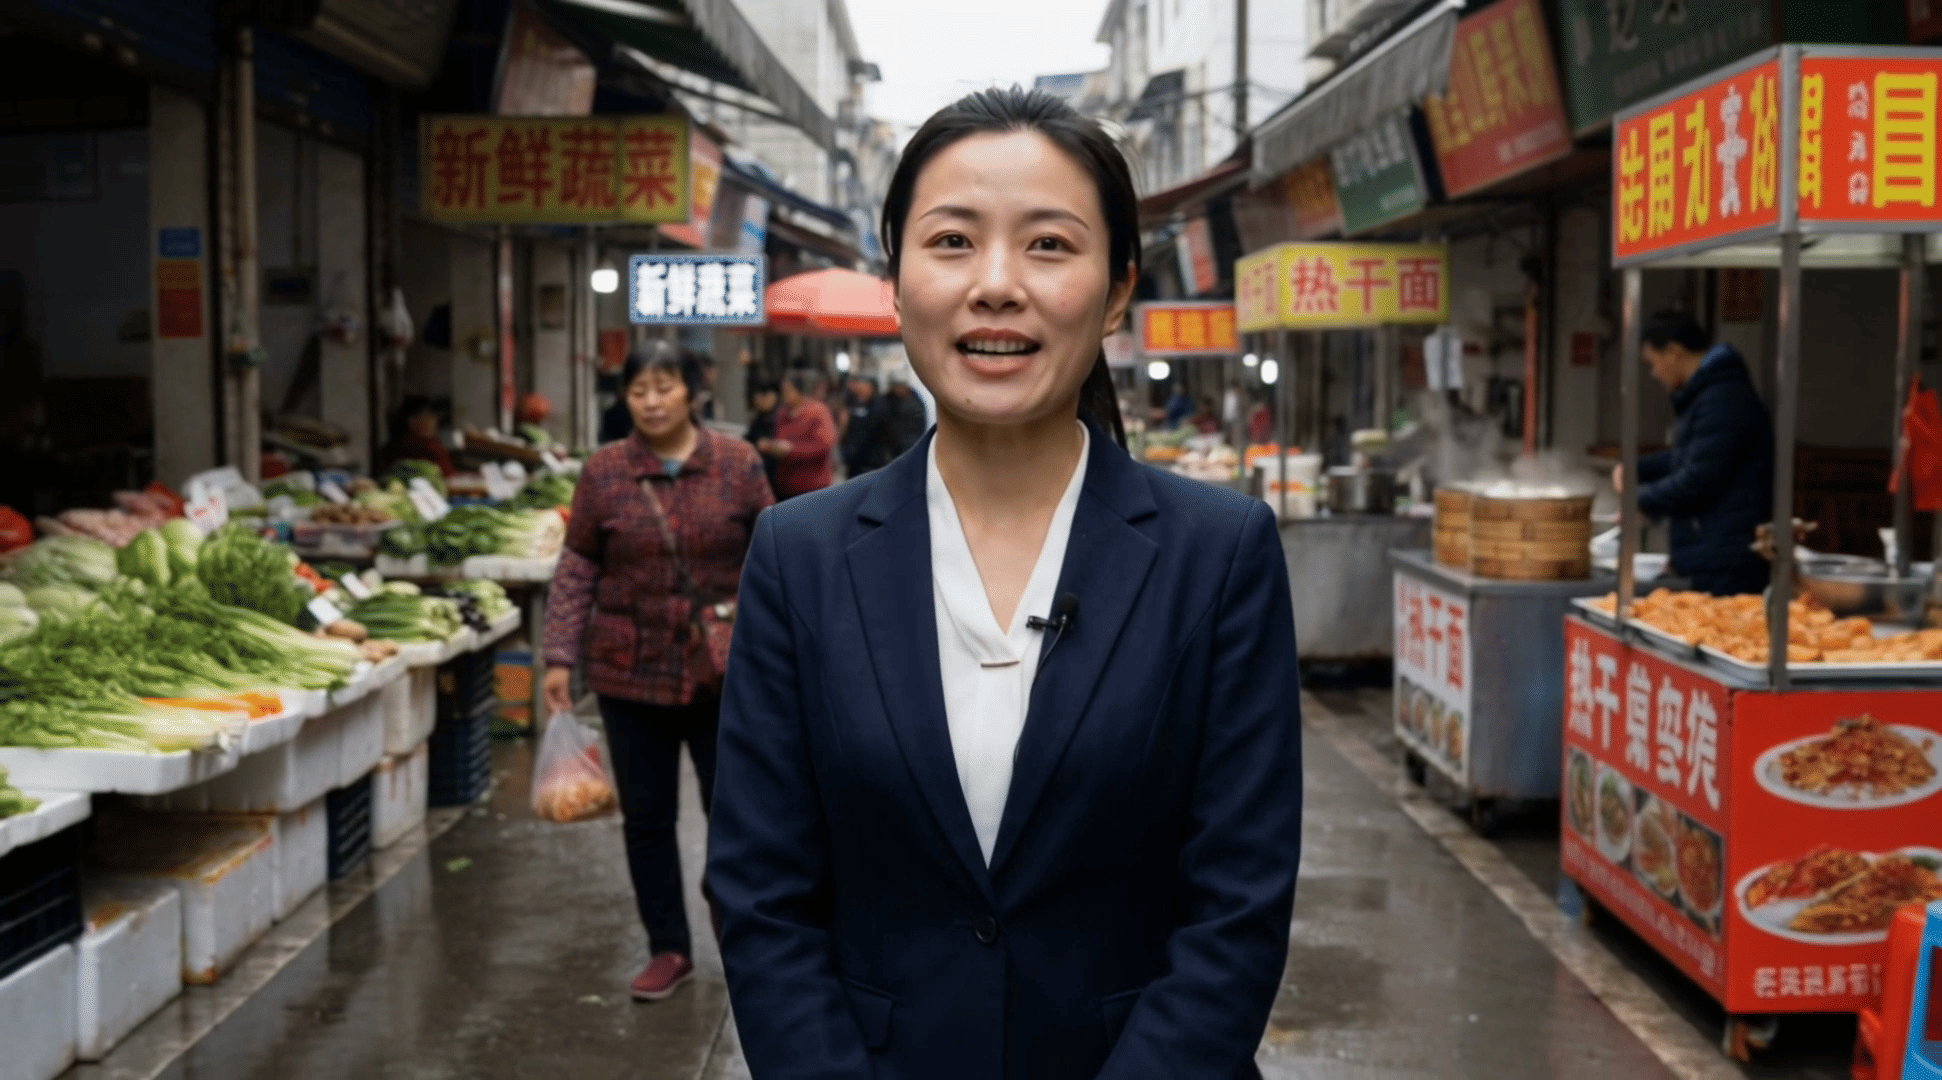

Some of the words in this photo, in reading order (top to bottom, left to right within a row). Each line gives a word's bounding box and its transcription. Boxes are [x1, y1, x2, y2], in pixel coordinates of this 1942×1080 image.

[433, 126, 677, 210] 新鲜蔬菜
[1291, 255, 1442, 314] 热干面
